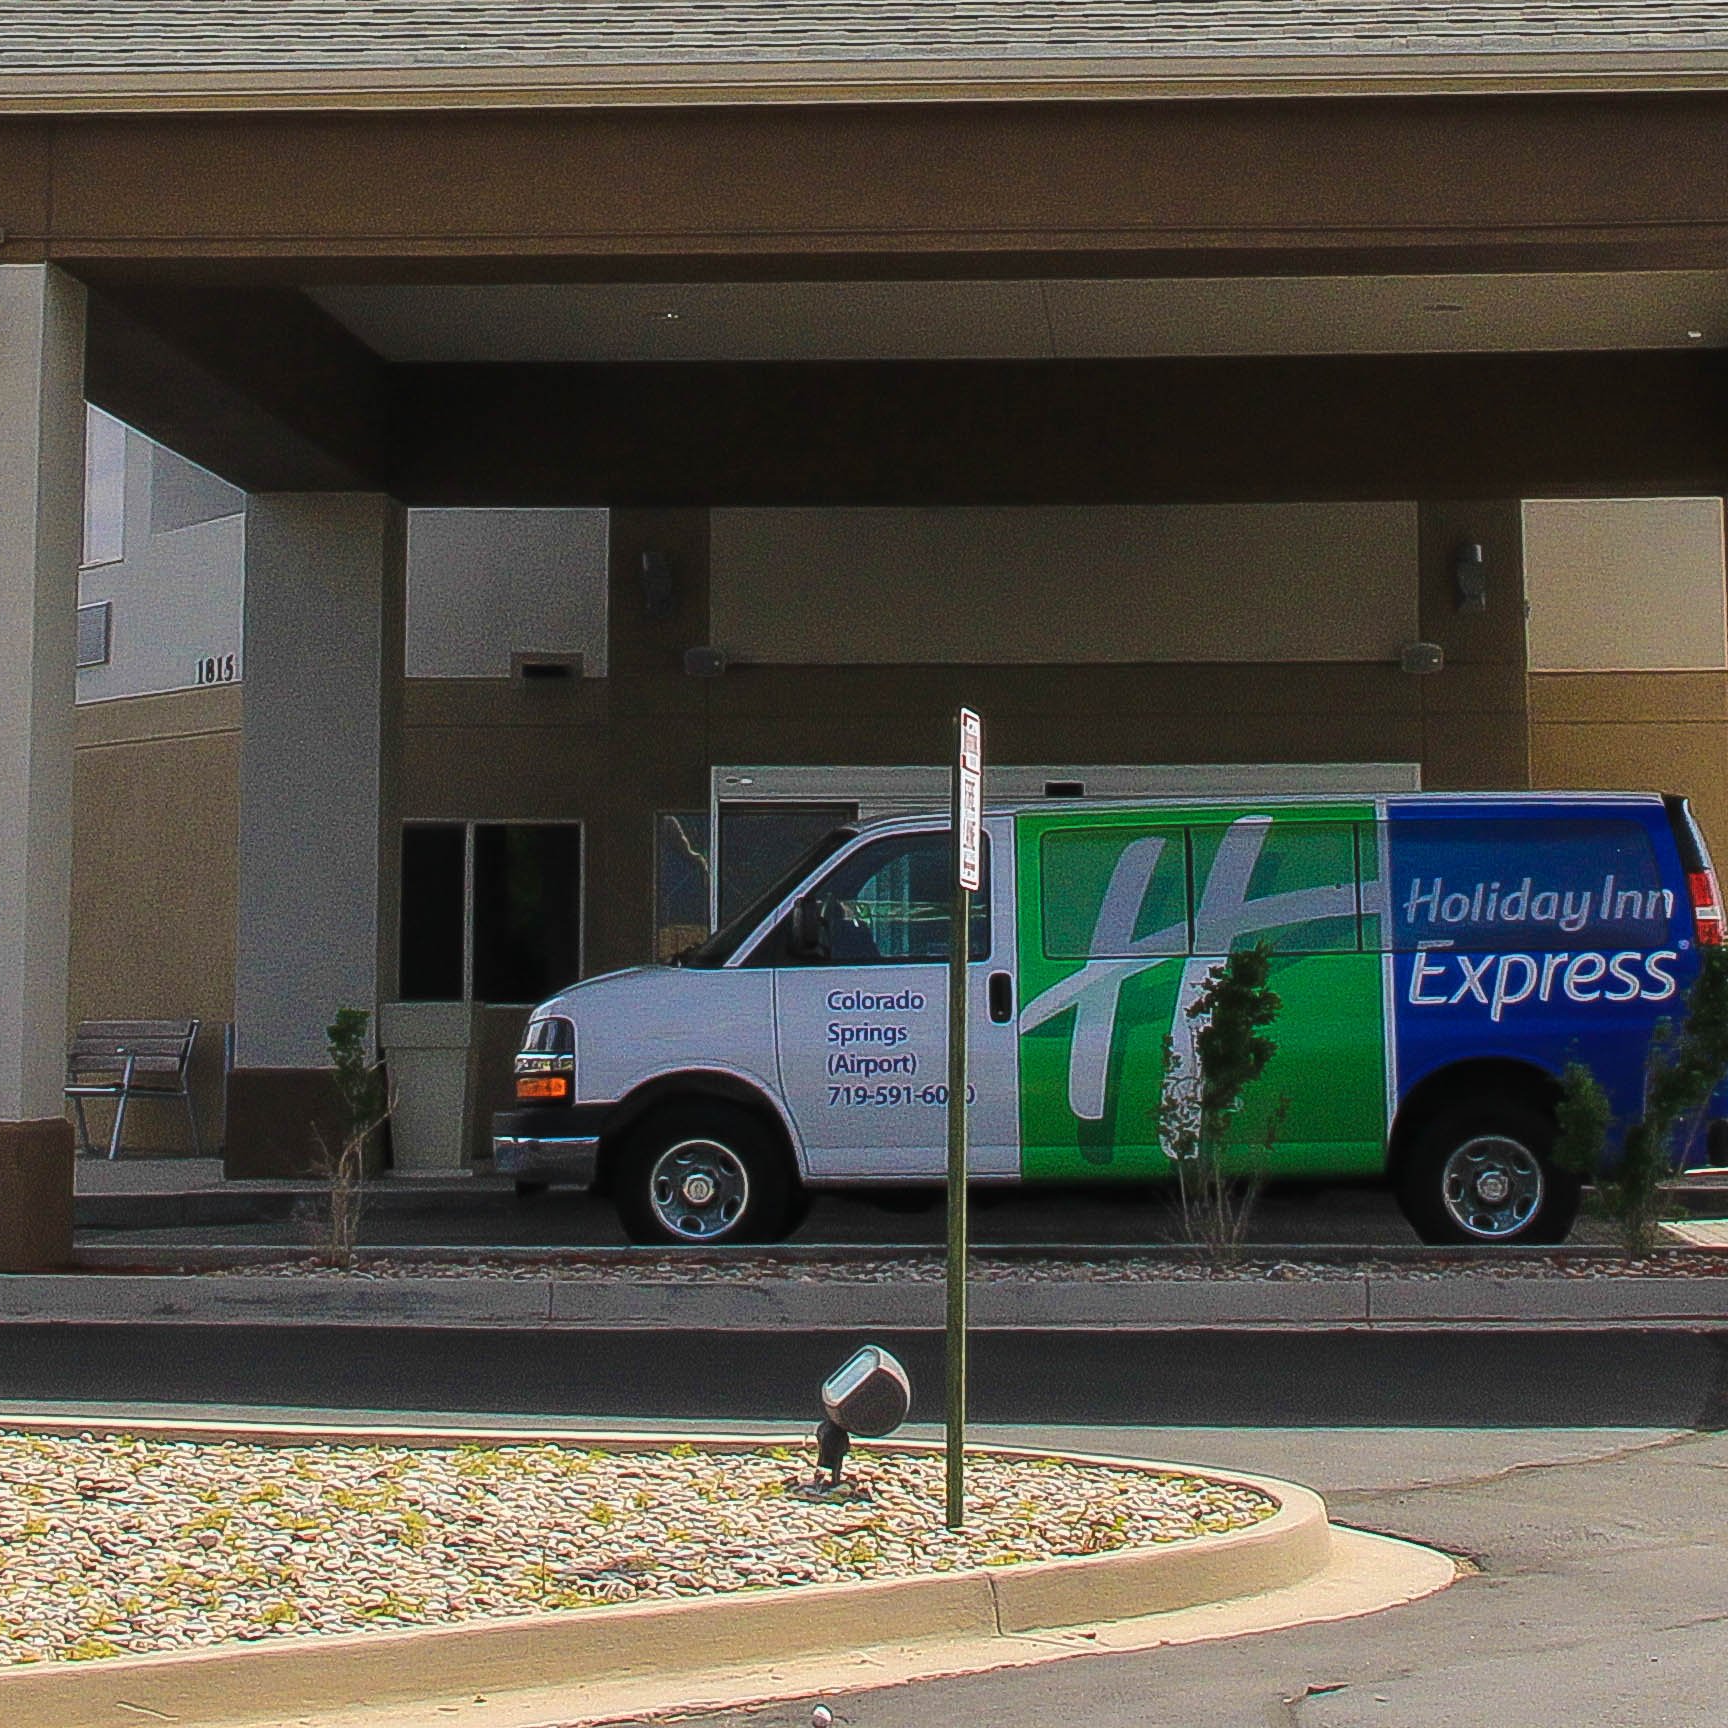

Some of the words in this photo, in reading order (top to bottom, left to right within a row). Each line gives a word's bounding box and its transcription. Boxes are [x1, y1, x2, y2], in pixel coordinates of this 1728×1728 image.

[194, 654, 234, 684] 1815
[1402, 876, 1592, 932] Holiday
[1598, 874, 1674, 920] Inn
[1408, 939, 1678, 1022] Express
[827, 989, 925, 1010] Colorado
[827, 1022, 908, 1047] Springs
[827, 1053, 917, 1078] (Airport)
[827, 1085, 976, 1106] 719-591-600
